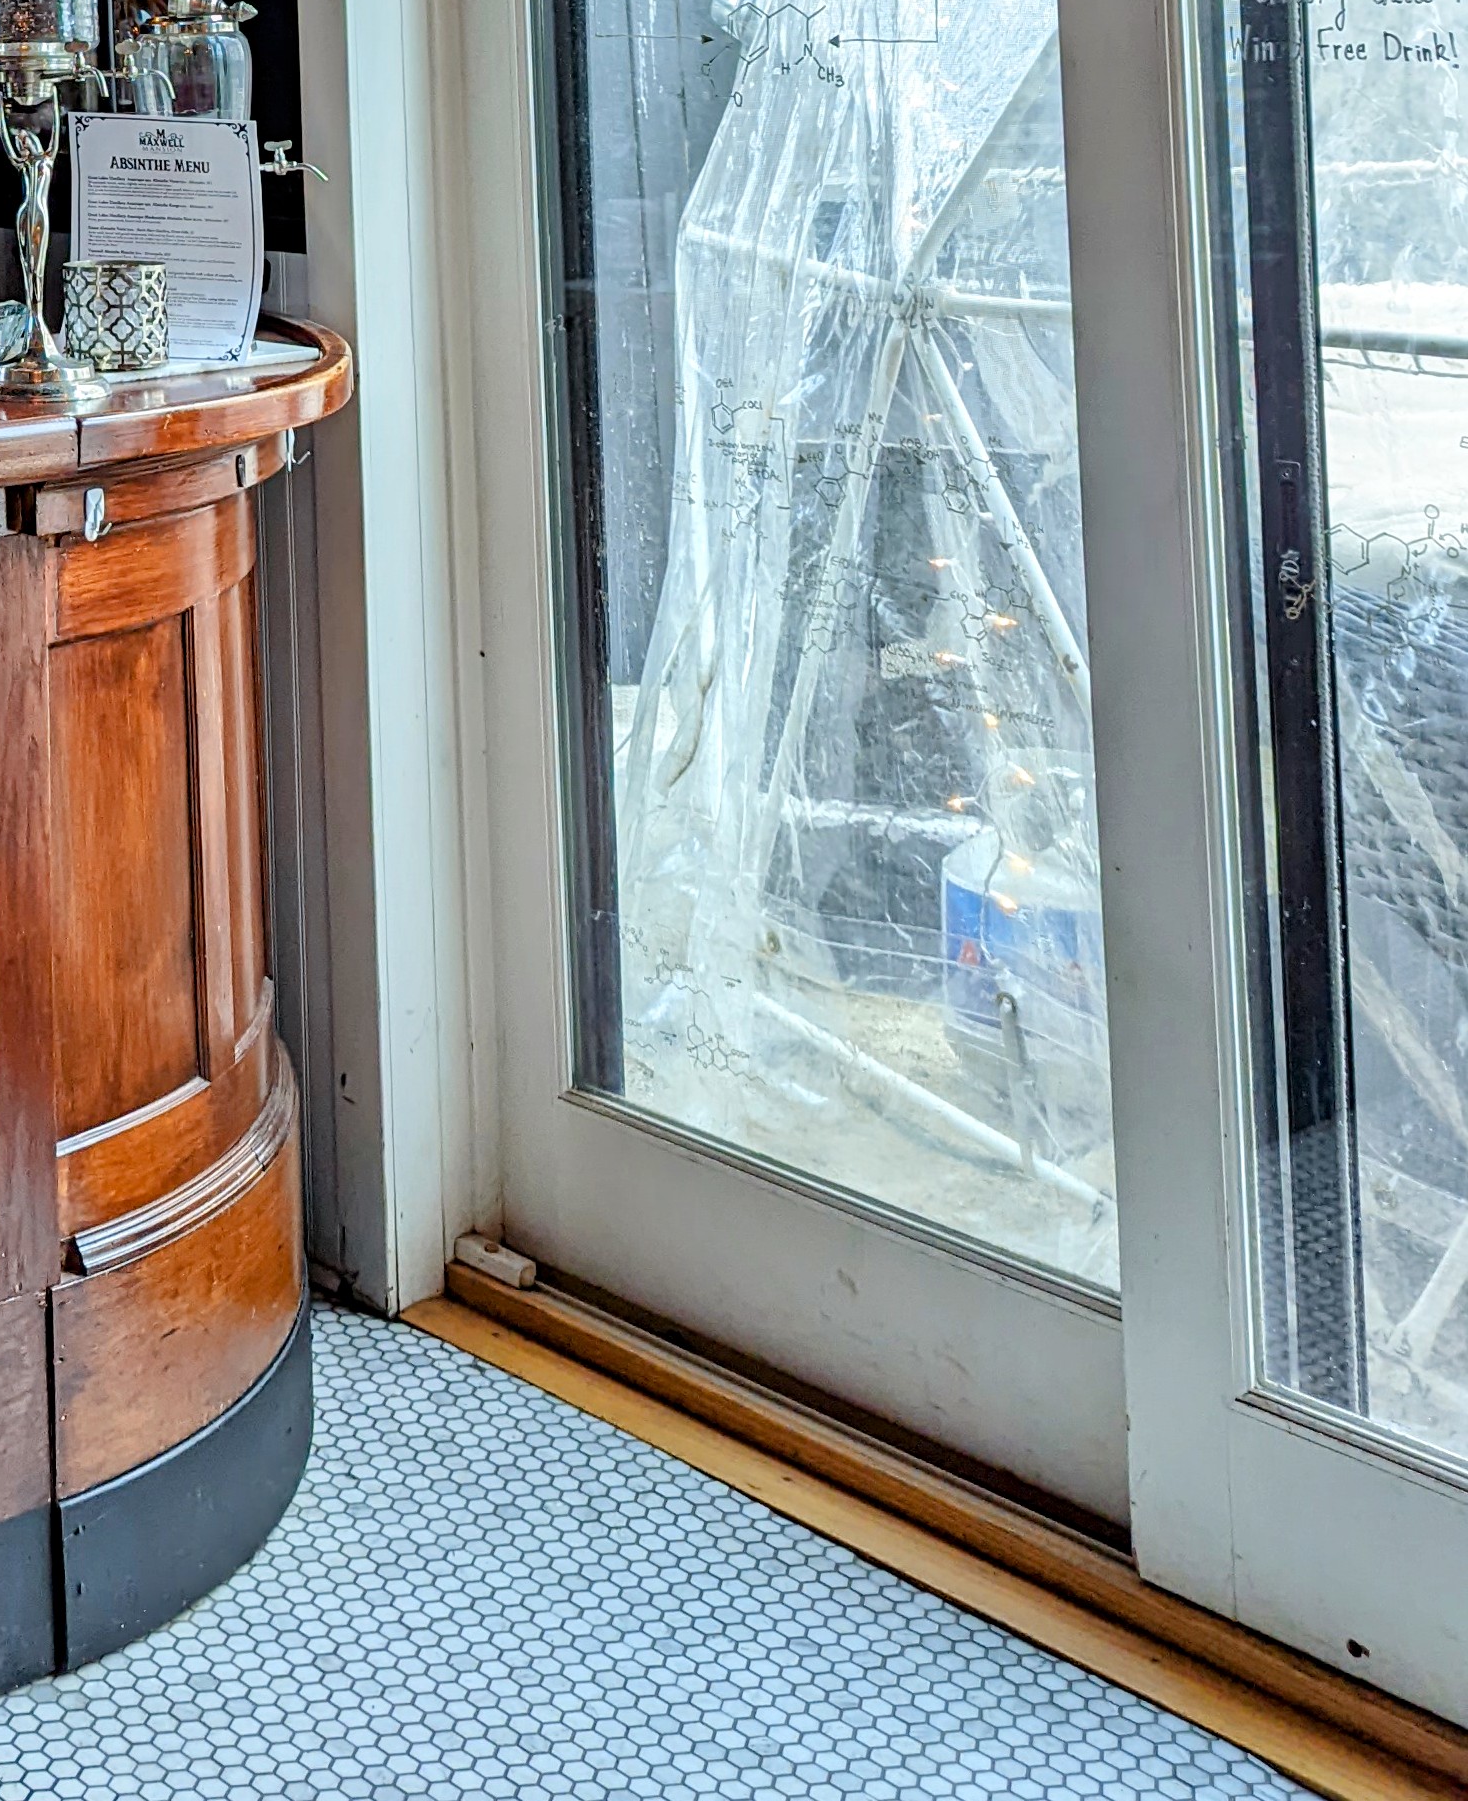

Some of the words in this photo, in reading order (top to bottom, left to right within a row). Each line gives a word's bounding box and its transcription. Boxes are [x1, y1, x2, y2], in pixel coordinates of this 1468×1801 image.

[1229, 24, 1275, 63] Win
[1316, 26, 1368, 62] Free
[1383, 31, 1460, 69] Drink!
[139, 137, 185, 148] MAXWELL
[110, 156, 171, 172] ABSINTHE
[175, 159, 210, 173] MENU
